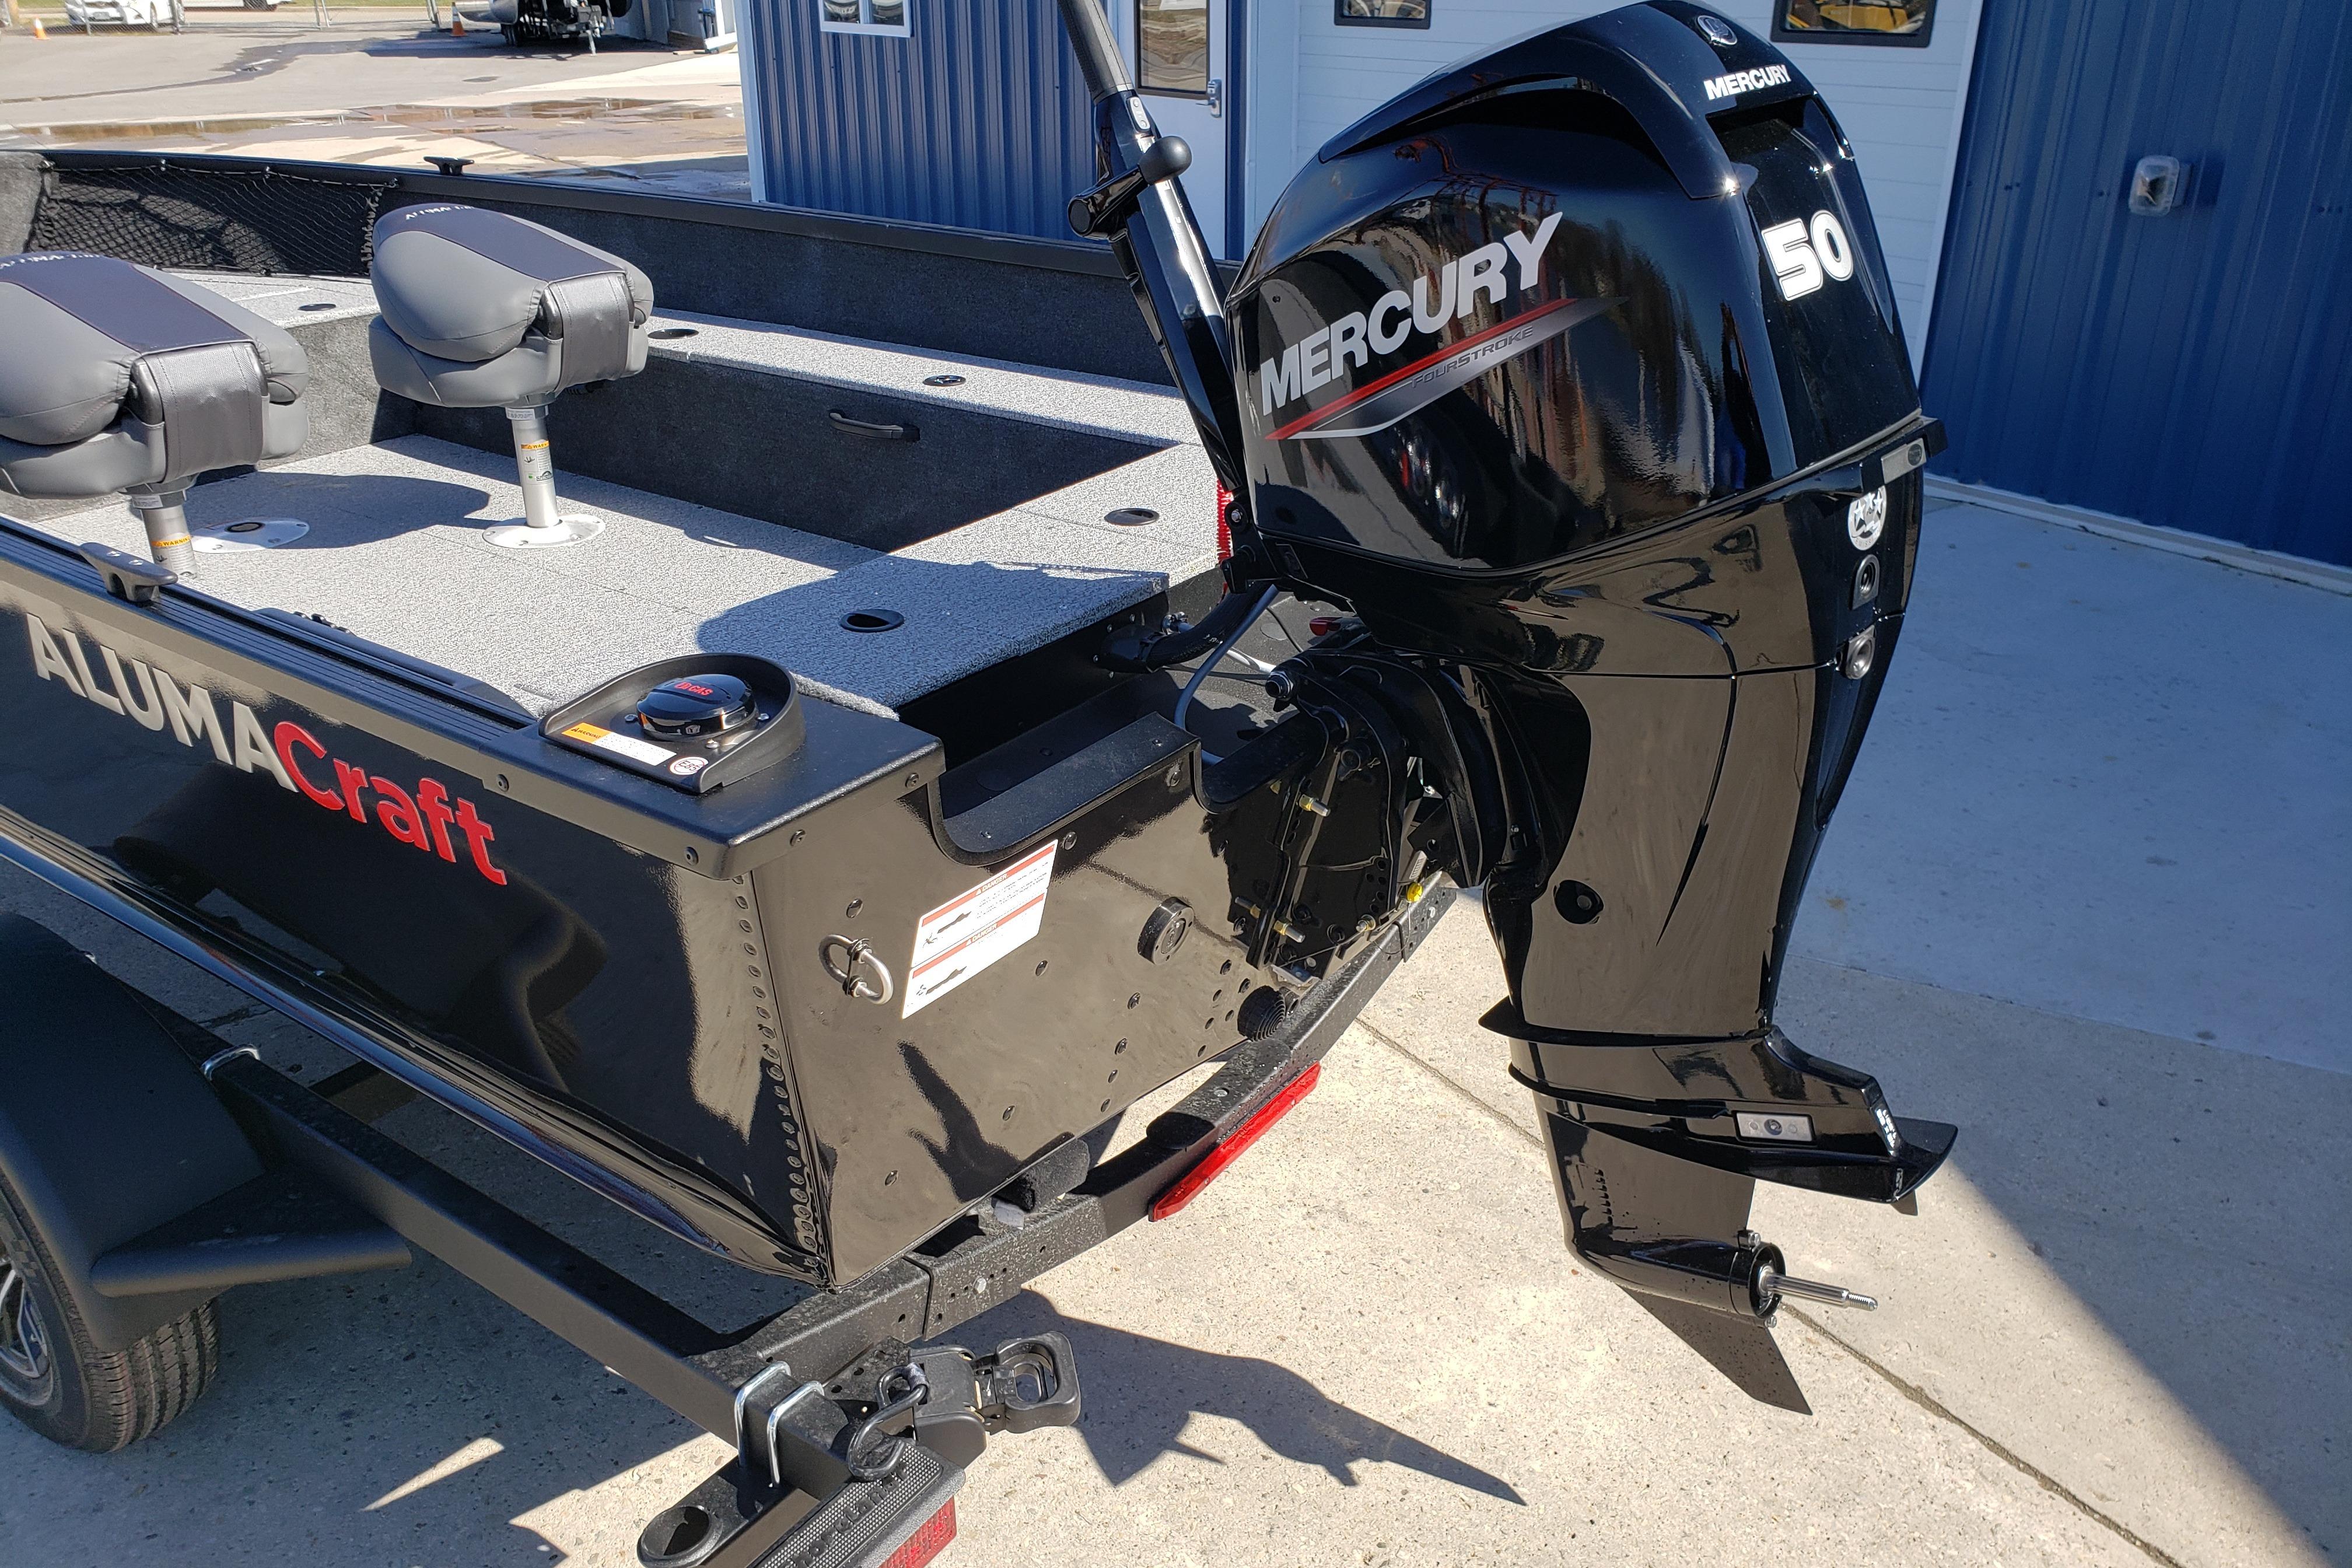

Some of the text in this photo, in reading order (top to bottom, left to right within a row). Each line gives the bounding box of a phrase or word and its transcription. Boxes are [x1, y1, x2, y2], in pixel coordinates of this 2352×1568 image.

[1703, 65, 1791, 100] MERCURY
[1761, 209, 1853, 301] 50
[1261, 212, 1563, 416] MERCURY
[1412, 326, 1533, 388] FOURSTROKE
[27, 614, 507, 886] ALUMACraft
[678, 761, 700, 771] E85
[982, 873, 1007, 892] DANGER
